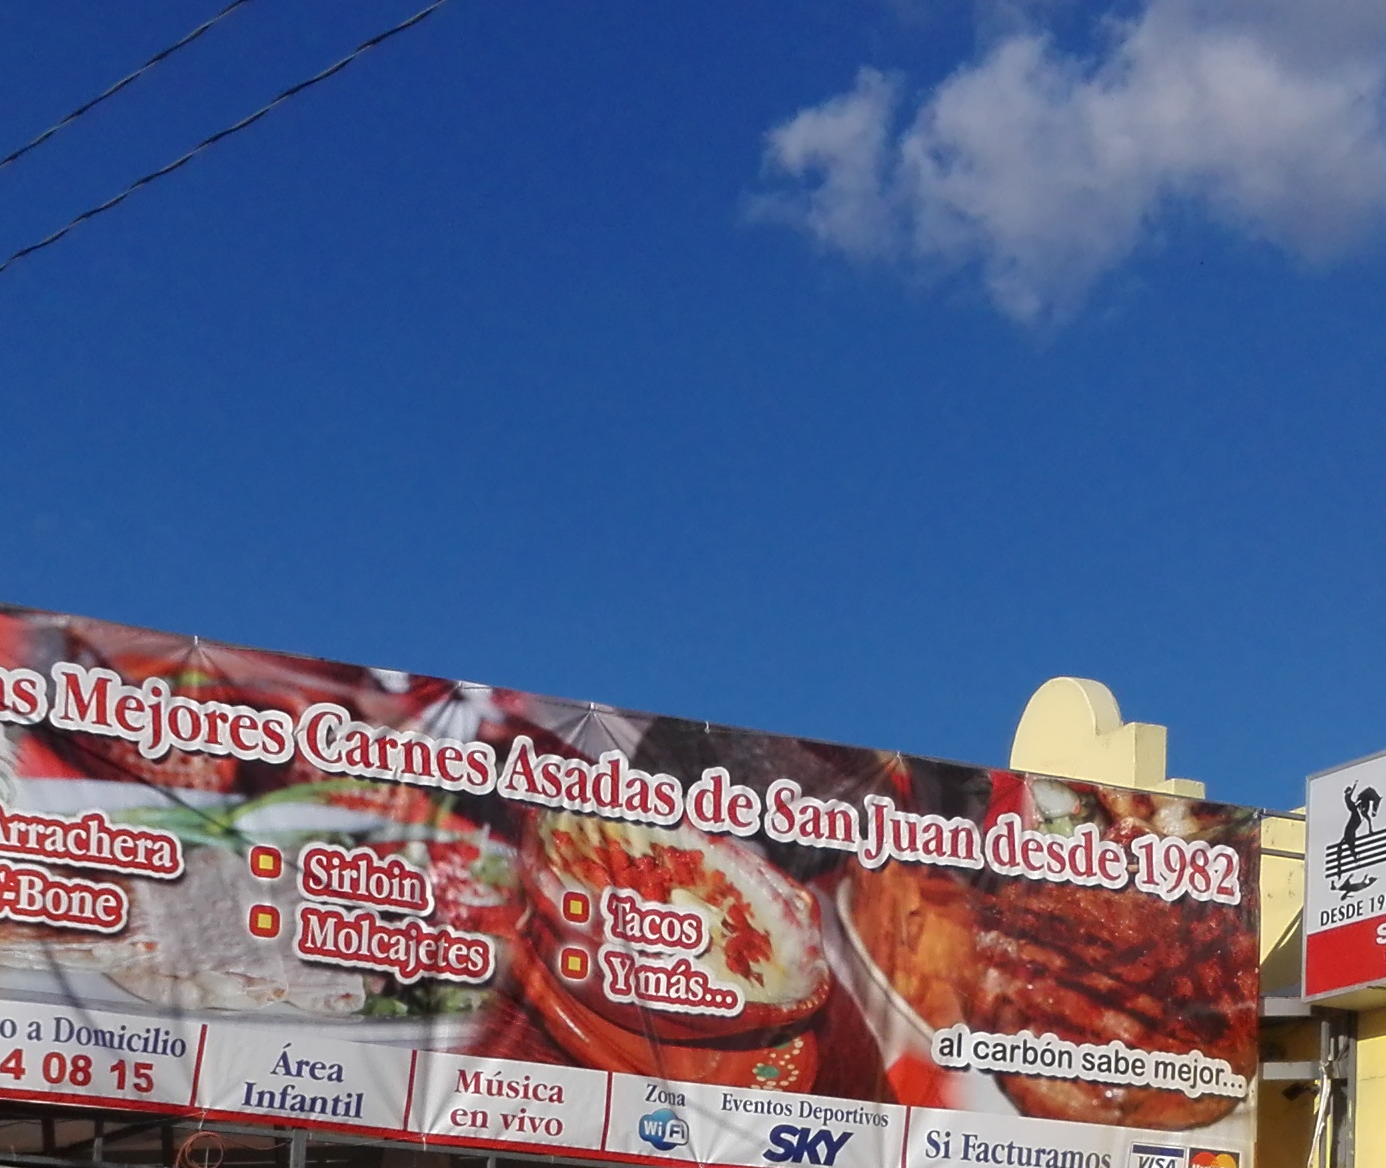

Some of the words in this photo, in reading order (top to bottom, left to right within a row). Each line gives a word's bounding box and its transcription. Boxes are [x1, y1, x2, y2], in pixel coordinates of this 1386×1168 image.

[61, 670, 288, 756] Mejores
[303, 710, 493, 788] Carnes
[507, 743, 679, 820] Asadas
[693, 776, 756, 829] de
[769, 785, 858, 846] San
[866, 803, 979, 864] Juan
[989, 821, 1124, 883] desde
[1137, 841, 1240, 899] 1982
[306, 849, 424, 907] Sirloin
[611, 895, 700, 946] Tacos
[1320, 902, 1364, 927] DESDE
[303, 911, 486, 978] Molcajetes
[609, 958, 634, 996] Y
[637, 961, 737, 1010] más...
[26, 1021, 43, 1042] a
[53, 1016, 188, 1058] Domicilio
[42, 1052, 93, 1087] 08
[110, 1059, 155, 1094] 15
[270, 1042, 344, 1083] Área
[939, 1033, 962, 1059] al
[972, 1037, 1074, 1070] carbón
[1081, 1050, 1146, 1077] sabe
[1154, 1058, 1244, 1092] mejor...
[242, 1081, 365, 1119] Infantil
[454, 1069, 566, 1104] Música
[645, 1083, 686, 1108] Zona
[450, 1107, 490, 1130] en
[499, 1107, 565, 1137] vivo
[721, 1093, 793, 1118] Eventos
[798, 1100, 890, 1128] Deportivos
[763, 1124, 855, 1167] SKY
[925, 1130, 951, 1160] Si
